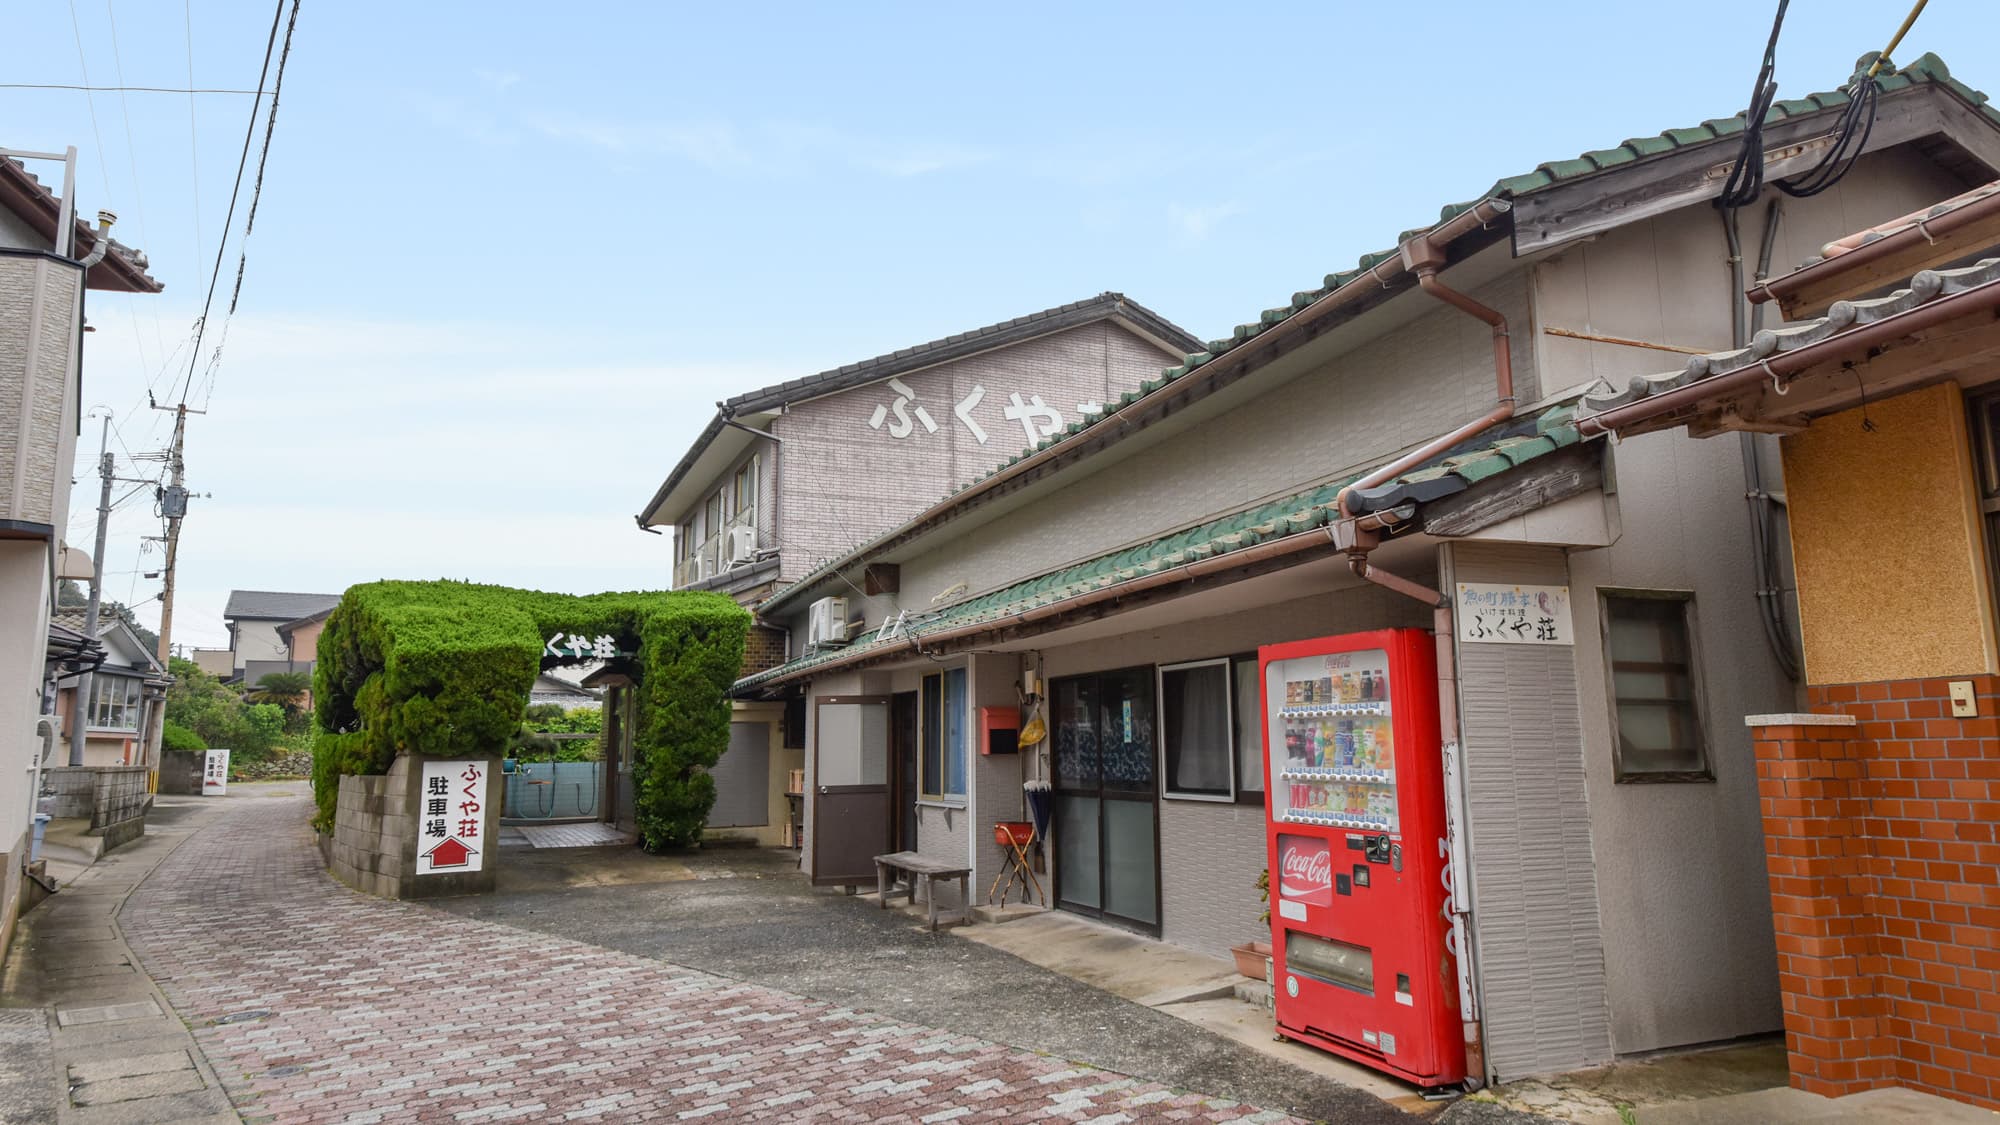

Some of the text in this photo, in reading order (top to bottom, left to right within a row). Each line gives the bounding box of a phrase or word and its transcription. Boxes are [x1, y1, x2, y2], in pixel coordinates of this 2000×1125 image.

[543, 632, 616, 659] くや荘
[1469, 615, 1559, 640] ふくや荘
[425, 775, 449, 838] 駐車場
[457, 763, 482, 838] ふくや荘
[1282, 846, 1332, 885] Coca-Col
